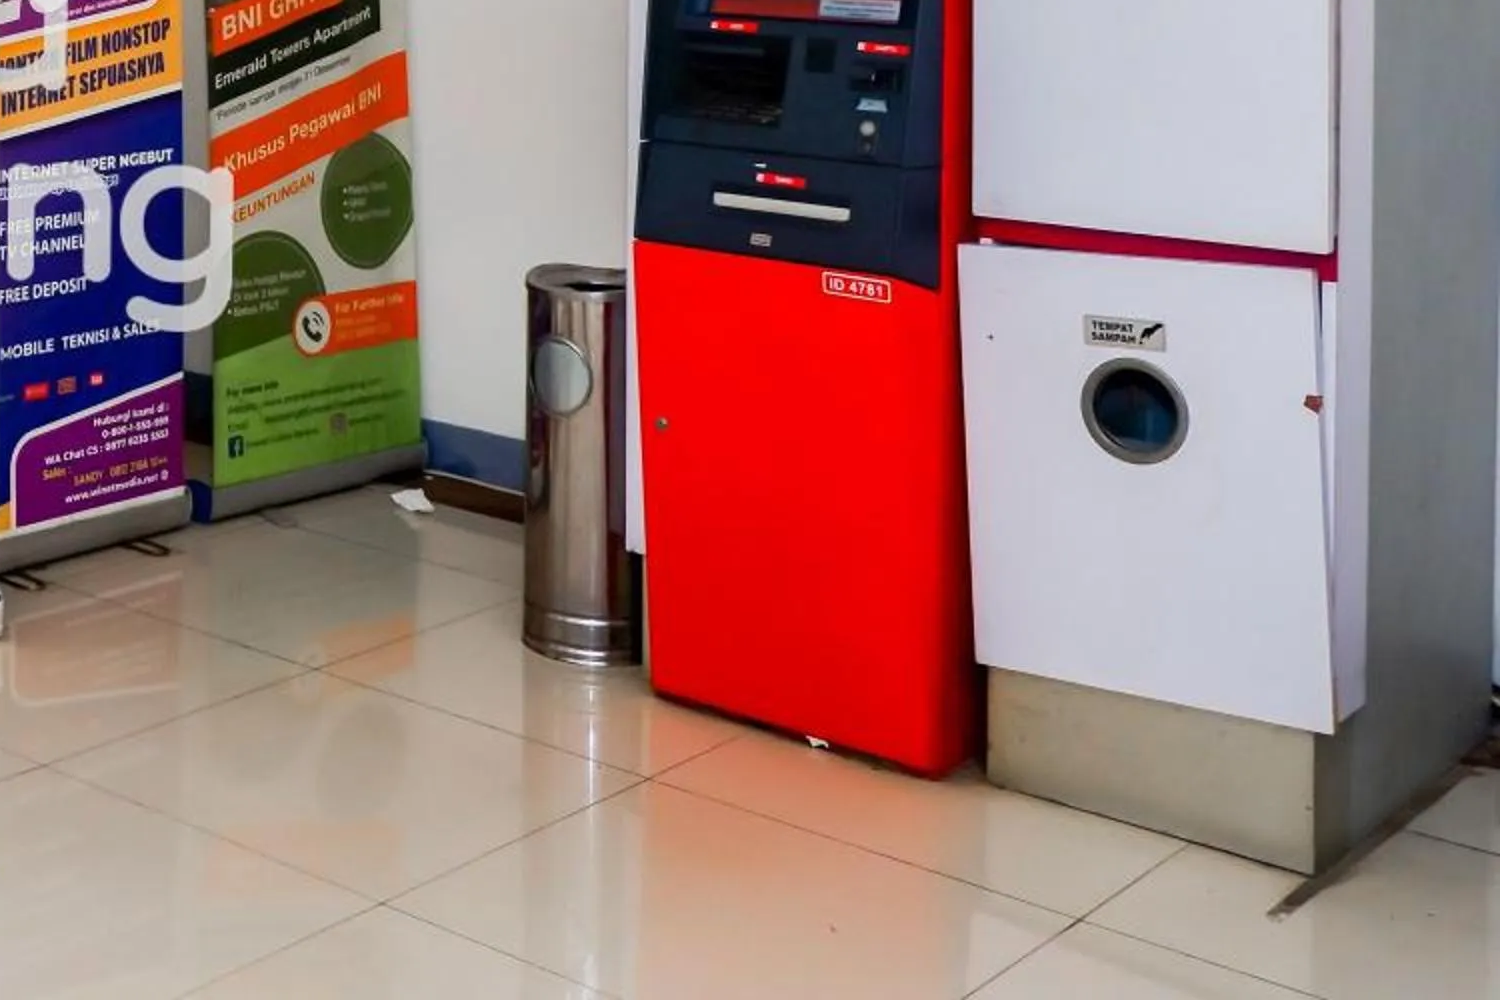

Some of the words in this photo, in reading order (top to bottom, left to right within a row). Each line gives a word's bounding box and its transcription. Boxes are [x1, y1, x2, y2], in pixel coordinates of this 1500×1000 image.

[221, 2, 262, 41] BNI
[101, 17, 171, 56] NONSTOP
[214, 55, 268, 90] Emerald
[270, 37, 311, 65] Towers
[313, 5, 373, 45] Apartment
[1, 76, 76, 117] INTERNET
[79, 51, 166, 95] SEPUASNYA
[224, 136, 285, 172] Khusus
[288, 102, 356, 144] Pegawai
[359, 81, 382, 110] BNI
[72, 154, 116, 174] SUPER
[118, 148, 174, 168] NGEBUT
[35, 211, 100, 232] PREMIUM
[21, 234, 86, 257] CHANNEL
[33, 276, 87, 300] DEPOSIT
[829, 277, 845, 291] ID
[849, 281, 884, 297] 4781
[1091, 319, 1134, 333] TEMPAT
[1091, 331, 1137, 344] SAMPAH
[0, 338, 55, 361] MOBILE
[61, 326, 110, 350] TEKNISI
[111, 325, 122, 340] &
